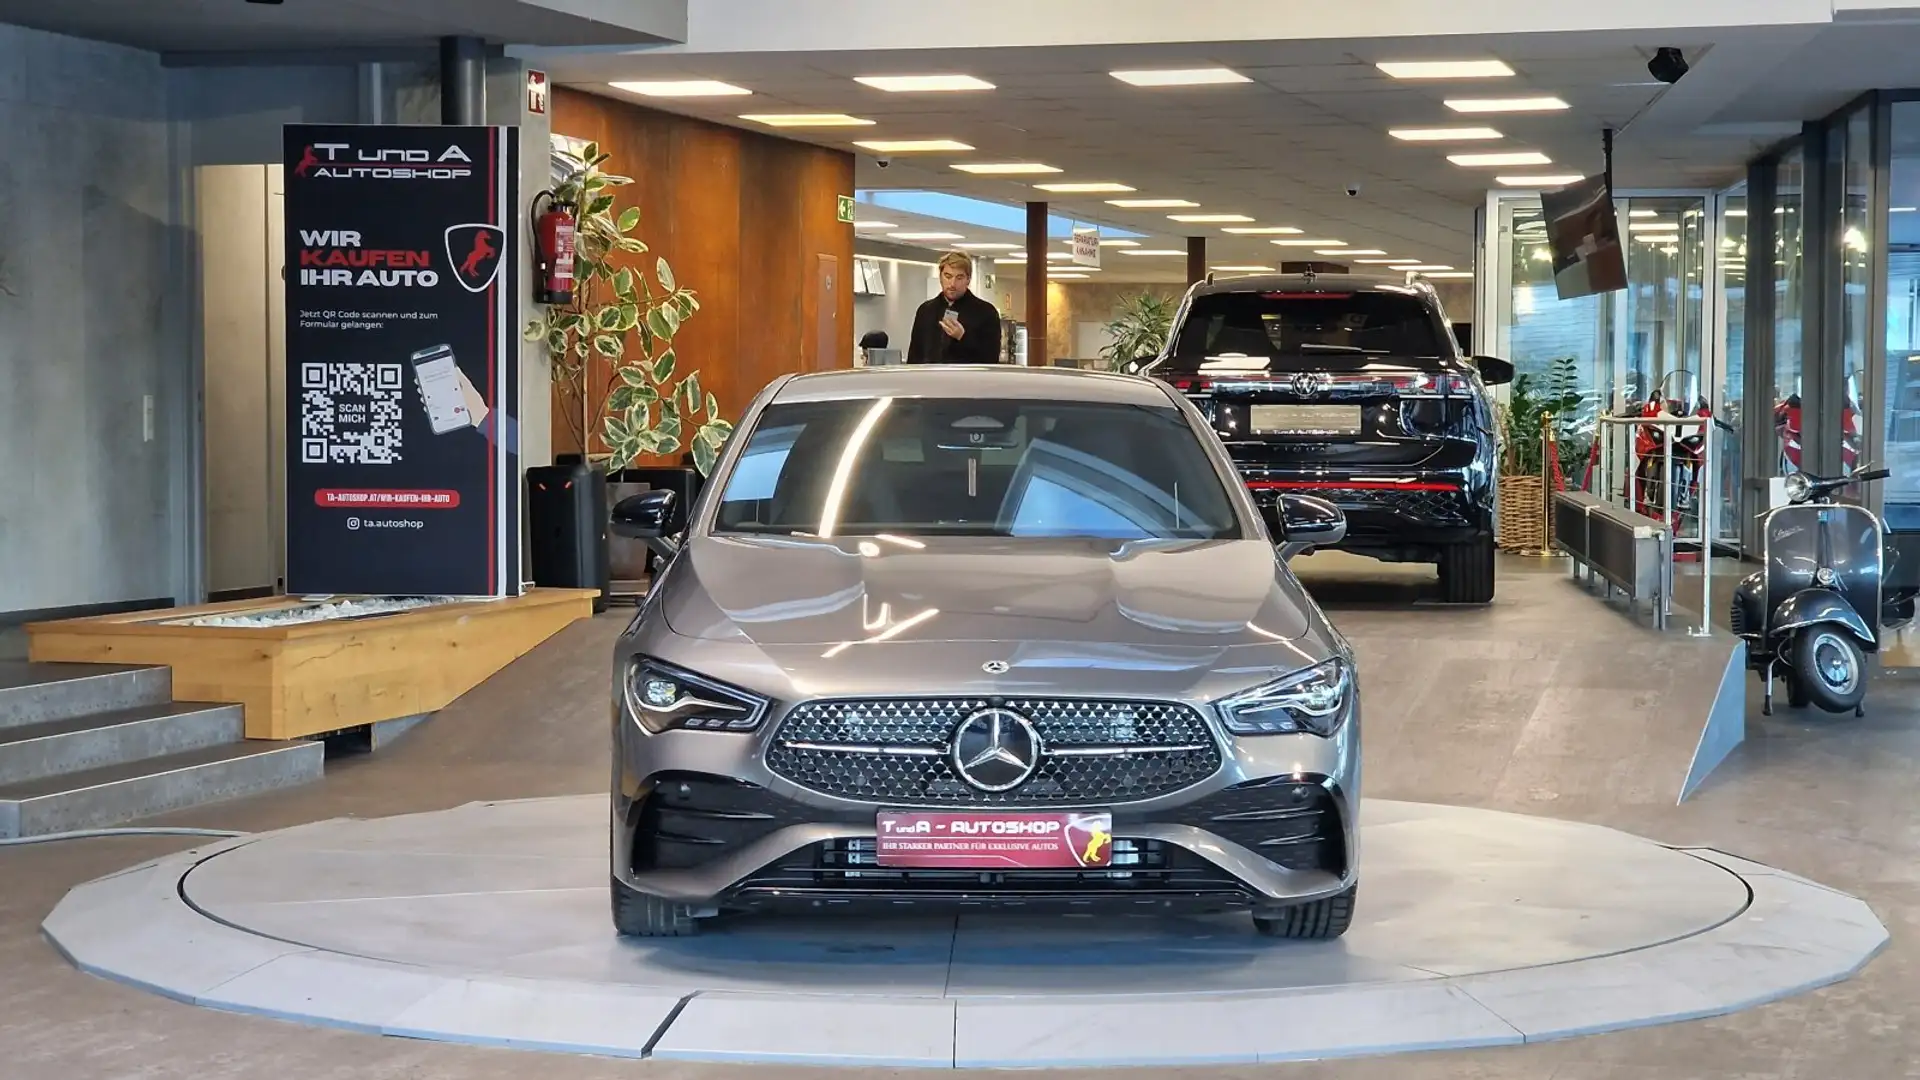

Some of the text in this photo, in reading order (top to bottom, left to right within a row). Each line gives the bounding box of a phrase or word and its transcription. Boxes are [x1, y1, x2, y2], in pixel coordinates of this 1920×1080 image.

[313, 143, 350, 161] T
[436, 144, 472, 162] A
[313, 167, 472, 179] AUTOSHOP
[299, 230, 361, 247] WIR
[300, 249, 430, 267] KAUFEN
[300, 269, 439, 287] IHR AUTO
[299, 310, 439, 320] Jetzt QR Code scannen und zum
[299, 320, 384, 330] Formular gelangen:
[338, 403, 366, 413] SCAN
[338, 413, 366, 424] MICH
[326, 492, 450, 503] TA-AUTOSHOP.AT/WIR-KAUFEN-IHR-AUTO
[363, 518, 424, 529] ta.autoshop
[950, 820, 1061, 834] AUTOSHOP
[882, 840, 1059, 851] IHR STARKER PARTNER FÜR EXKLUSIVE AUTOS
